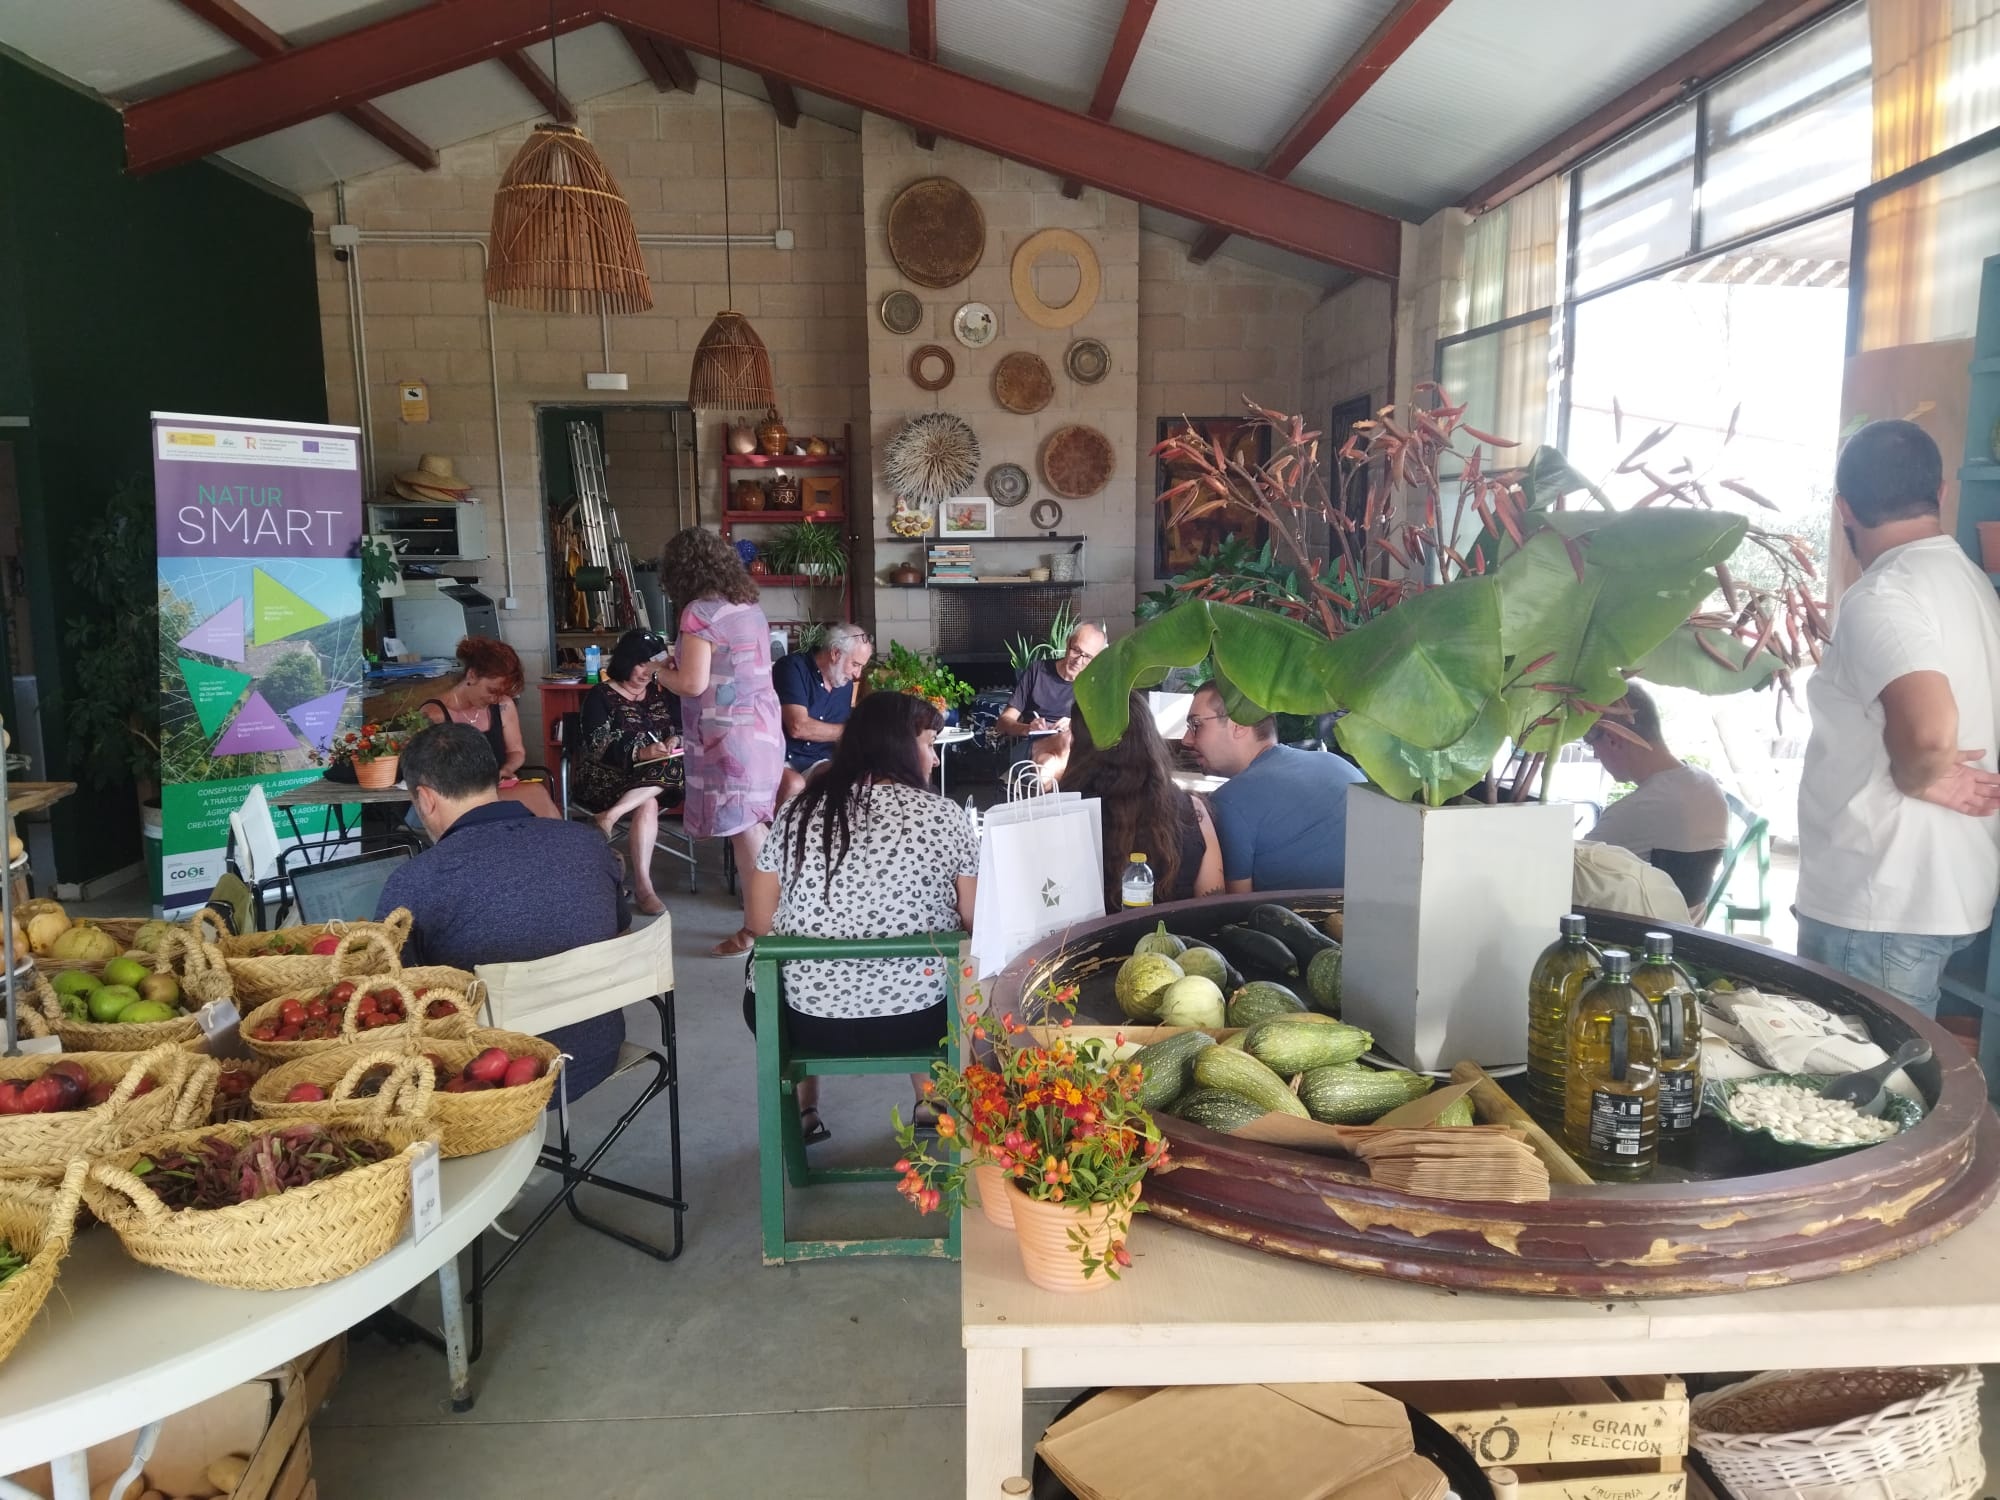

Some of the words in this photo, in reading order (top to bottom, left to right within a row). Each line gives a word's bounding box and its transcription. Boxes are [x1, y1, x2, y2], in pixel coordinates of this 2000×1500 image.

[199, 485, 283, 507] NATUR
[177, 506, 343, 546] SMART
[1592, 1419, 1647, 1437] GRAN
[1570, 1433, 1662, 1456] SELECCIÓN
